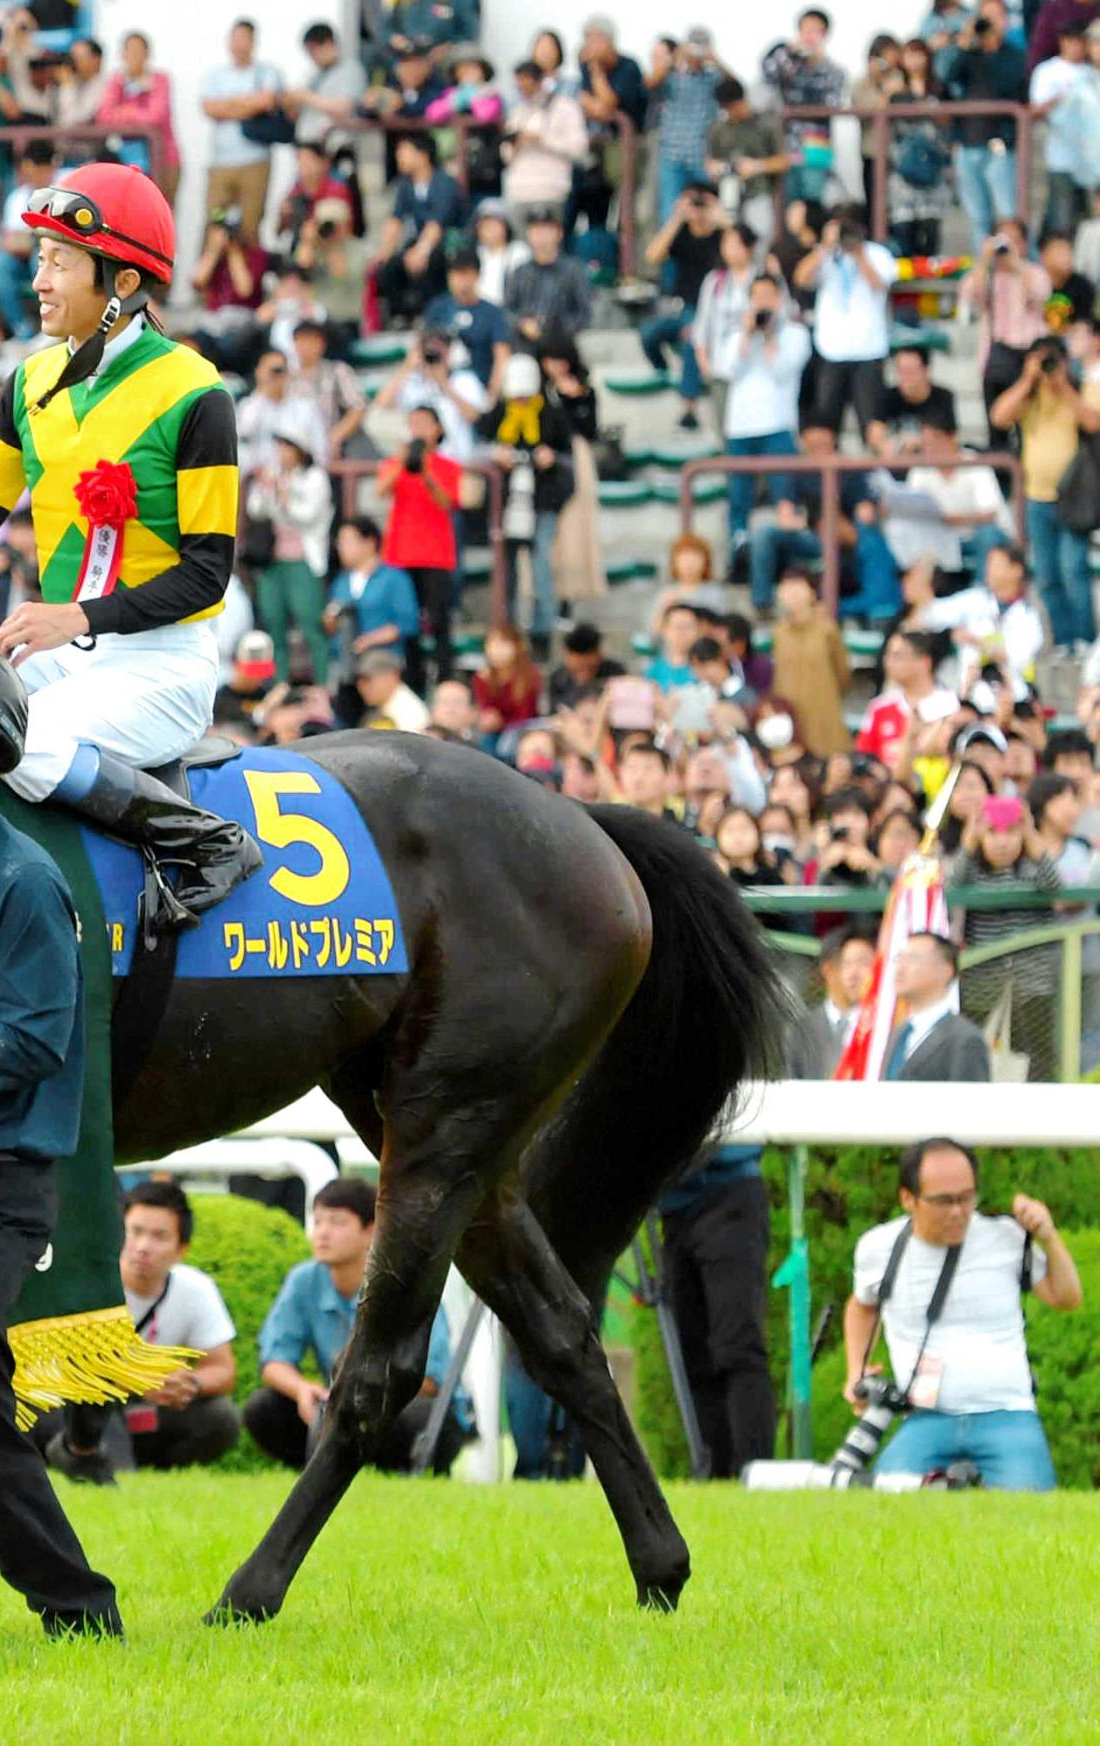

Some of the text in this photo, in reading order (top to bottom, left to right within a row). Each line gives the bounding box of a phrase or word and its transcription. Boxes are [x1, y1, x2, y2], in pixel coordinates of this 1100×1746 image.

[242, 769, 351, 907] 5
[222, 916, 395, 972] ワールドプレミア
